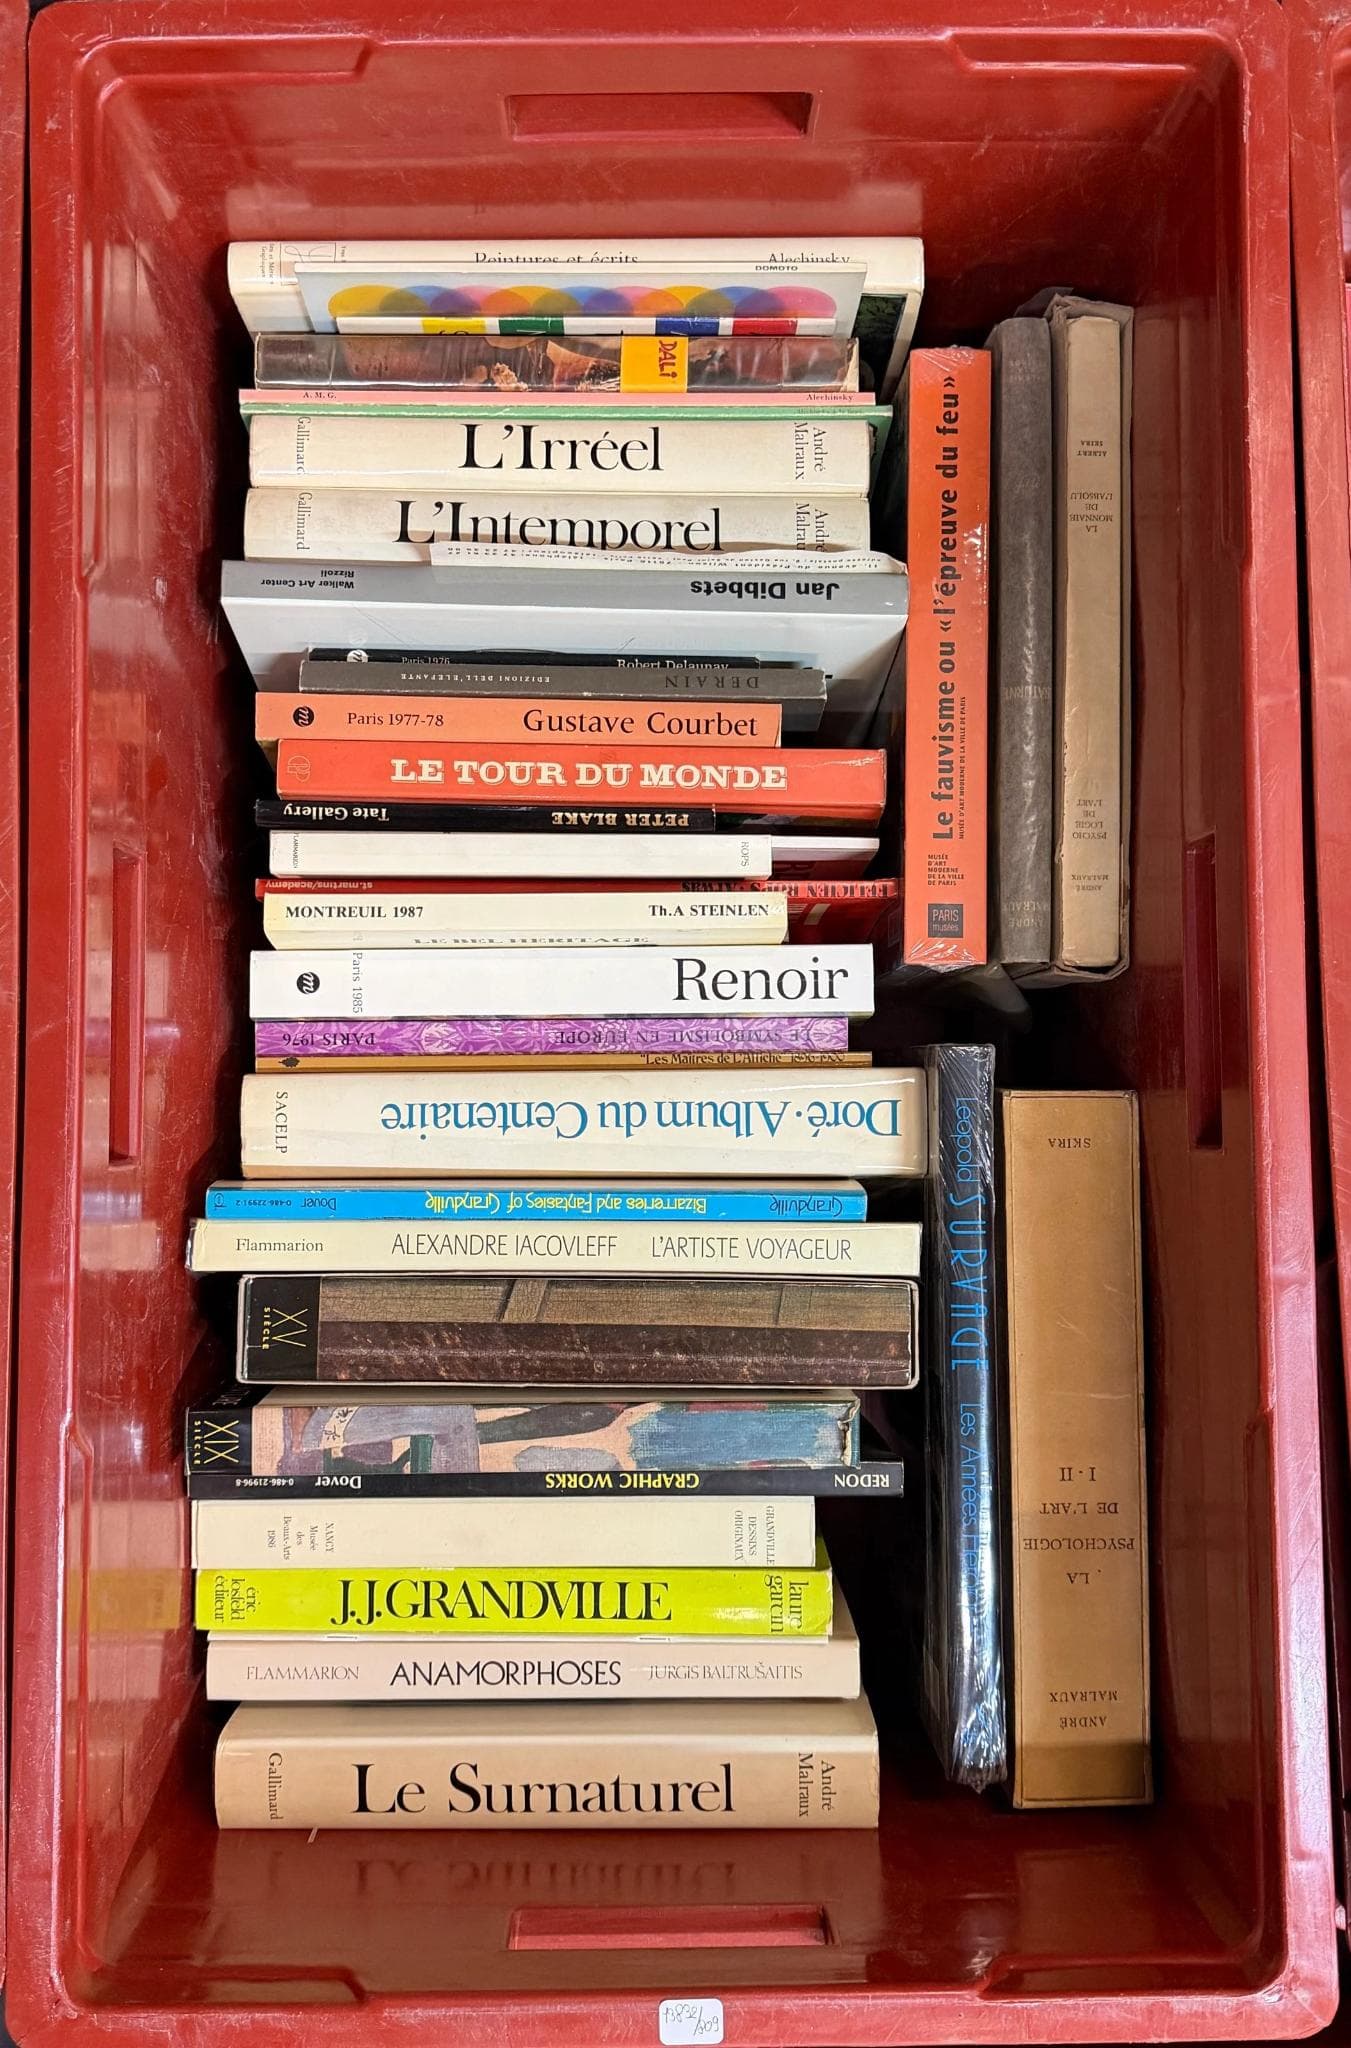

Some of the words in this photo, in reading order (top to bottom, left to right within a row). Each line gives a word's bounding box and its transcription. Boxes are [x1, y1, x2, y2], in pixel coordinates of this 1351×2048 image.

[806, 394, 853, 402] Alechinsky
[935, 393, 959, 436] feu
[458, 423, 664, 471] L'Irréel
[794, 422, 805, 480] Malraux
[813, 427, 826, 473] André
[935, 446, 958, 479] du
[1085, 503, 1098, 511] DE
[296, 492, 312, 550] Gallimard
[392, 499, 723, 551] L'Intemporel
[796, 503, 809, 550] Malrau
[1069, 515, 1113, 523] MONNAIE
[1086, 525, 1098, 533] LA
[261, 578, 295, 588] Center
[300, 579, 315, 588] Art
[321, 570, 354, 578] Rizzoli
[318, 579, 354, 589] Walker
[691, 580, 785, 599] Dibbets
[796, 582, 840, 600] Jan
[617, 659, 661, 668] Robert
[940, 641, 955, 674] ou
[499, 675, 550, 683] EDIZIONI
[665, 675, 759, 688] DERAIN
[348, 711, 384, 726] Paris
[388, 713, 443, 727] 1977-78
[524, 709, 635, 733] Gustave
[647, 711, 758, 736] Courbet
[959, 717, 966, 725] DE
[931, 680, 955, 808] fauvisme
[959, 745, 966, 754] LA
[958, 755, 966, 764] DE
[390, 758, 444, 784] LE
[454, 760, 566, 787] TOUR
[575, 763, 632, 789] DU
[640, 764, 787, 791] MONDE
[958, 766, 966, 797] MODERNE
[283, 803, 349, 820] Gallery
[352, 806, 389, 821] Tate
[958, 797, 966, 817] D'ART
[1083, 810, 1096, 818] DE
[551, 811, 617, 826] BLAKE
[624, 812, 689, 827] PETER
[933, 812, 954, 840] Le
[1075, 821, 1103, 829] LOGIE
[957, 819, 965, 840] MUSÉE
[741, 841, 749, 867] ROPS
[806, 882, 889, 898] FELICIEN
[285, 905, 386, 918] MONTREUIL
[393, 905, 423, 918] 1987
[690, 904, 769, 917] STEINLEN
[932, 909, 959, 922] PARIS
[353, 952, 363, 982] Paris
[672, 956, 849, 1001] Renoir
[353, 986, 363, 1014] 1985
[282, 1032, 315, 1046] 1976
[323, 1032, 376, 1046] PARIS
[555, 1030, 627, 1044] EUROPE
[636, 1030, 658, 1043] EN
[672, 1029, 785, 1042] SYMBOLISME
[790, 1029, 815, 1041] LE
[717, 1053, 730, 1064] de
[275, 1091, 288, 1154] SACELP
[380, 1101, 588, 1140] Centenaire
[598, 1100, 647, 1138] du
[1048, 1137, 1091, 1149] SKIRA
[301, 1196, 336, 1211] Dover
[425, 1190, 499, 1215] Grandville
[507, 1192, 523, 1214] of
[527, 1193, 592, 1213] Fantasies
[597, 1197, 621, 1212] and
[625, 1197, 707, 1214] Bizarreries
[769, 1195, 843, 1216] Grandville
[236, 1238, 323, 1252] Flammarion
[392, 1233, 507, 1255] ALEXANDRE
[515, 1234, 618, 1257] IACOVLEFF
[652, 1236, 739, 1258] L'ARTISTE
[746, 1238, 852, 1260] VOYAGEUR
[272, 1308, 308, 1347] XV
[959, 1403, 982, 1436] Les
[203, 1420, 239, 1463] XIX
[235, 1478, 294, 1487] 0-486-21996-8
[315, 1475, 362, 1489] Dover
[545, 1472, 613, 1488] WORKS
[619, 1473, 700, 1489] GRAPHIC
[834, 1474, 889, 1488] REDON
[1039, 1502, 1087, 1514] L'ART
[1097, 1502, 1119, 1514] DE
[283, 1515, 292, 1560] Beaux-Arts
[309, 1525, 319, 1551] Musée
[325, 1522, 334, 1552] NANCY
[734, 1510, 743, 1561] ORIGINAUX
[747, 1516, 757, 1556] DESSINS
[766, 1504, 775, 1566] GRANDVILLE
[1023, 1537, 1135, 1550] PSYCHOLOGIE
[1066, 1572, 1090, 1585] LA
[214, 1575, 226, 1623] éditeur
[231, 1578, 245, 1621] losfeld
[247, 1586, 261, 1613] éric
[330, 1579, 672, 1626] J.J.GRANDVILLE
[764, 1574, 783, 1633] garcin
[789, 1581, 809, 1630] laure
[246, 1665, 359, 1681] FLAMMARION
[390, 1660, 622, 1686] ANAMORPHOSES
[647, 1664, 699, 1680] JURGIS
[703, 1661, 803, 1680] BALTRUŠAITIS
[1049, 1690, 1118, 1702] MALRAUX
[1059, 1716, 1107, 1730] ANDRÉ
[268, 1752, 283, 1820] Gallimard
[351, 1763, 426, 1814] Le
[448, 1762, 736, 1814] Surnaturel
[798, 1752, 813, 1818] Malraux
[821, 1760, 837, 1811] André
